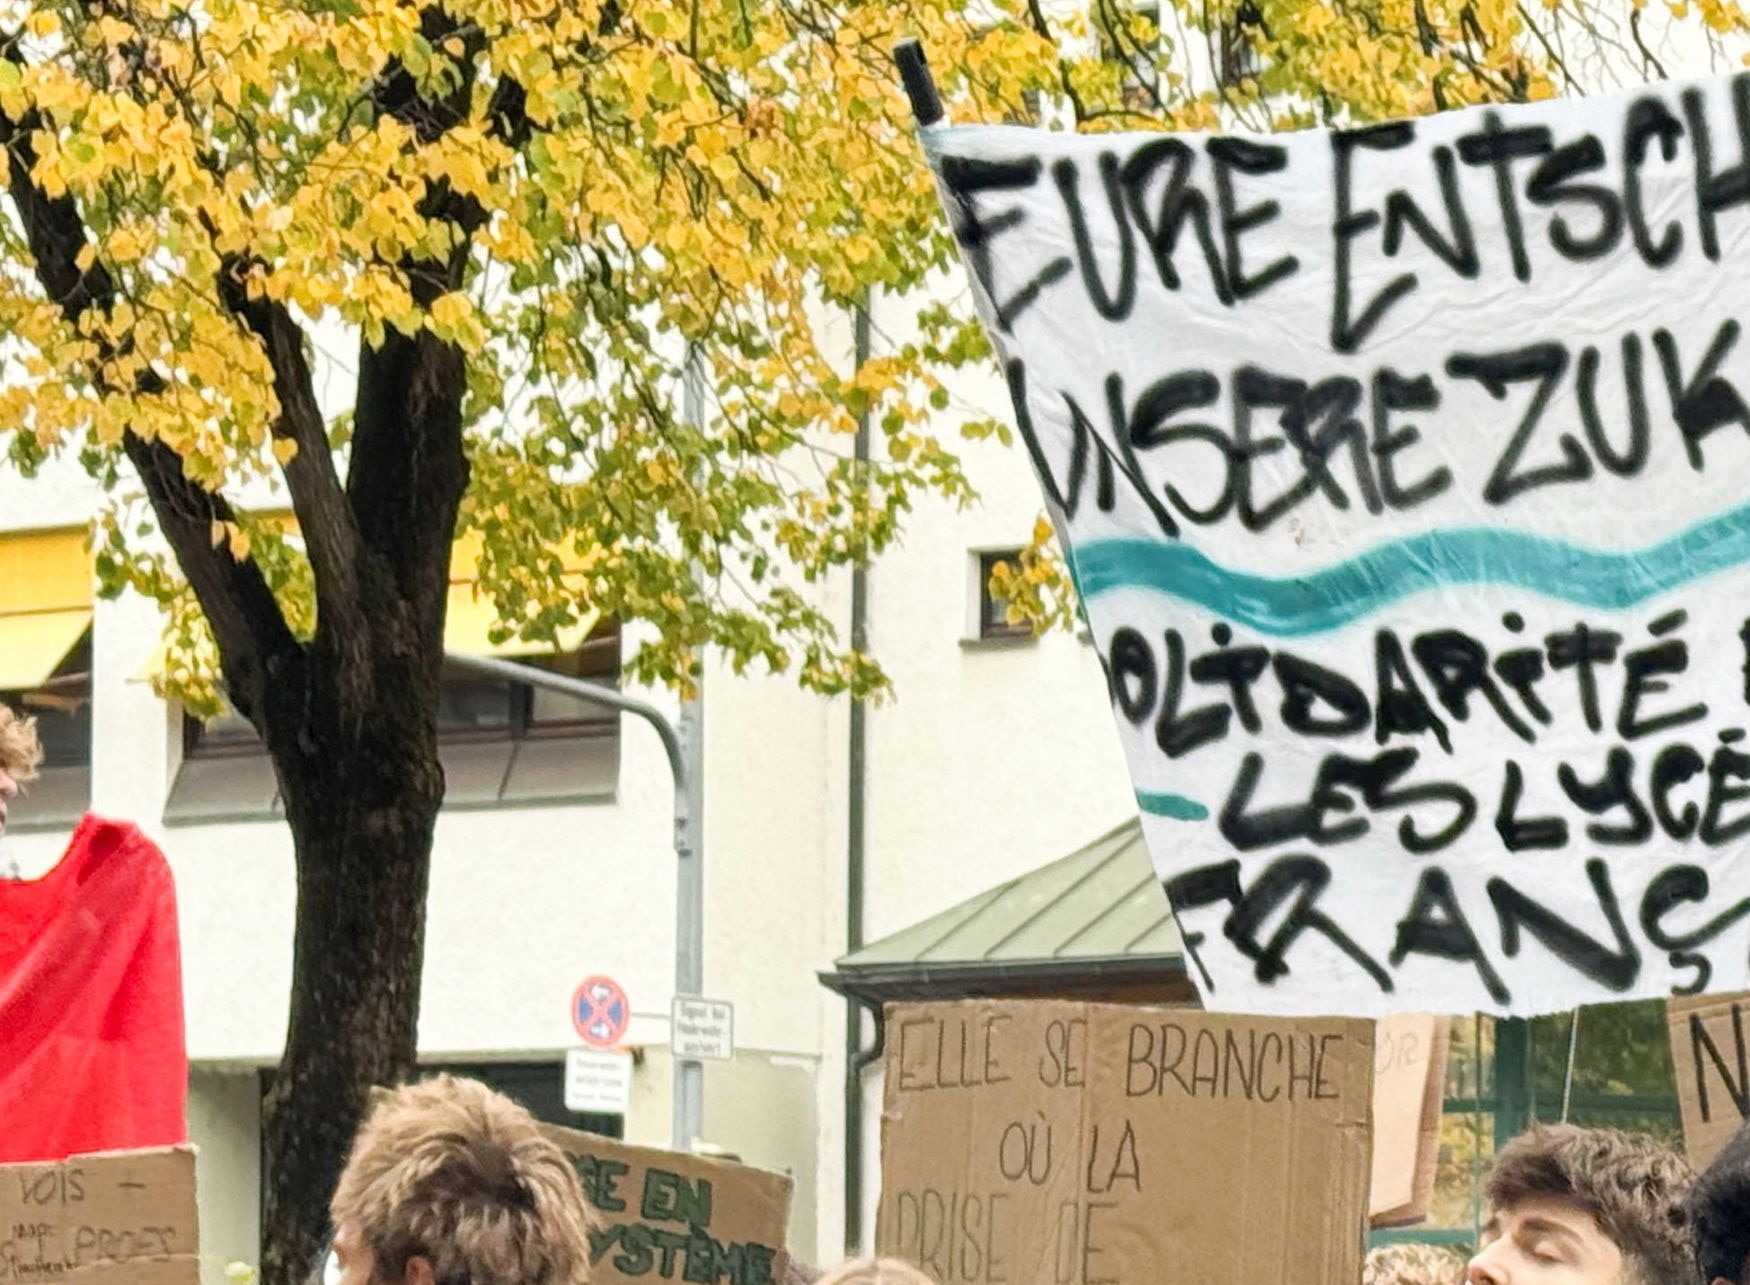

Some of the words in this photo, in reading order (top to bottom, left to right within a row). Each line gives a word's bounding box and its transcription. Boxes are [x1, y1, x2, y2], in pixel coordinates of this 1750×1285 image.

[942, 137, 1300, 336] EURE
[1006, 358, 1453, 538] UNSERE
[1218, 748, 1478, 855] LES
[900, 1016, 1012, 1091] ELLE
[1038, 1018, 1088, 1089] SE
[1126, 1023, 1344, 1102] BRANCHE
[640, 1167, 715, 1229] EN
[1000, 1111, 1054, 1186] OÙ
[1086, 1119, 1142, 1193] LA
[897, 1187, 1010, 1285] PRISE
[1054, 1199, 1121, 1285] DE
